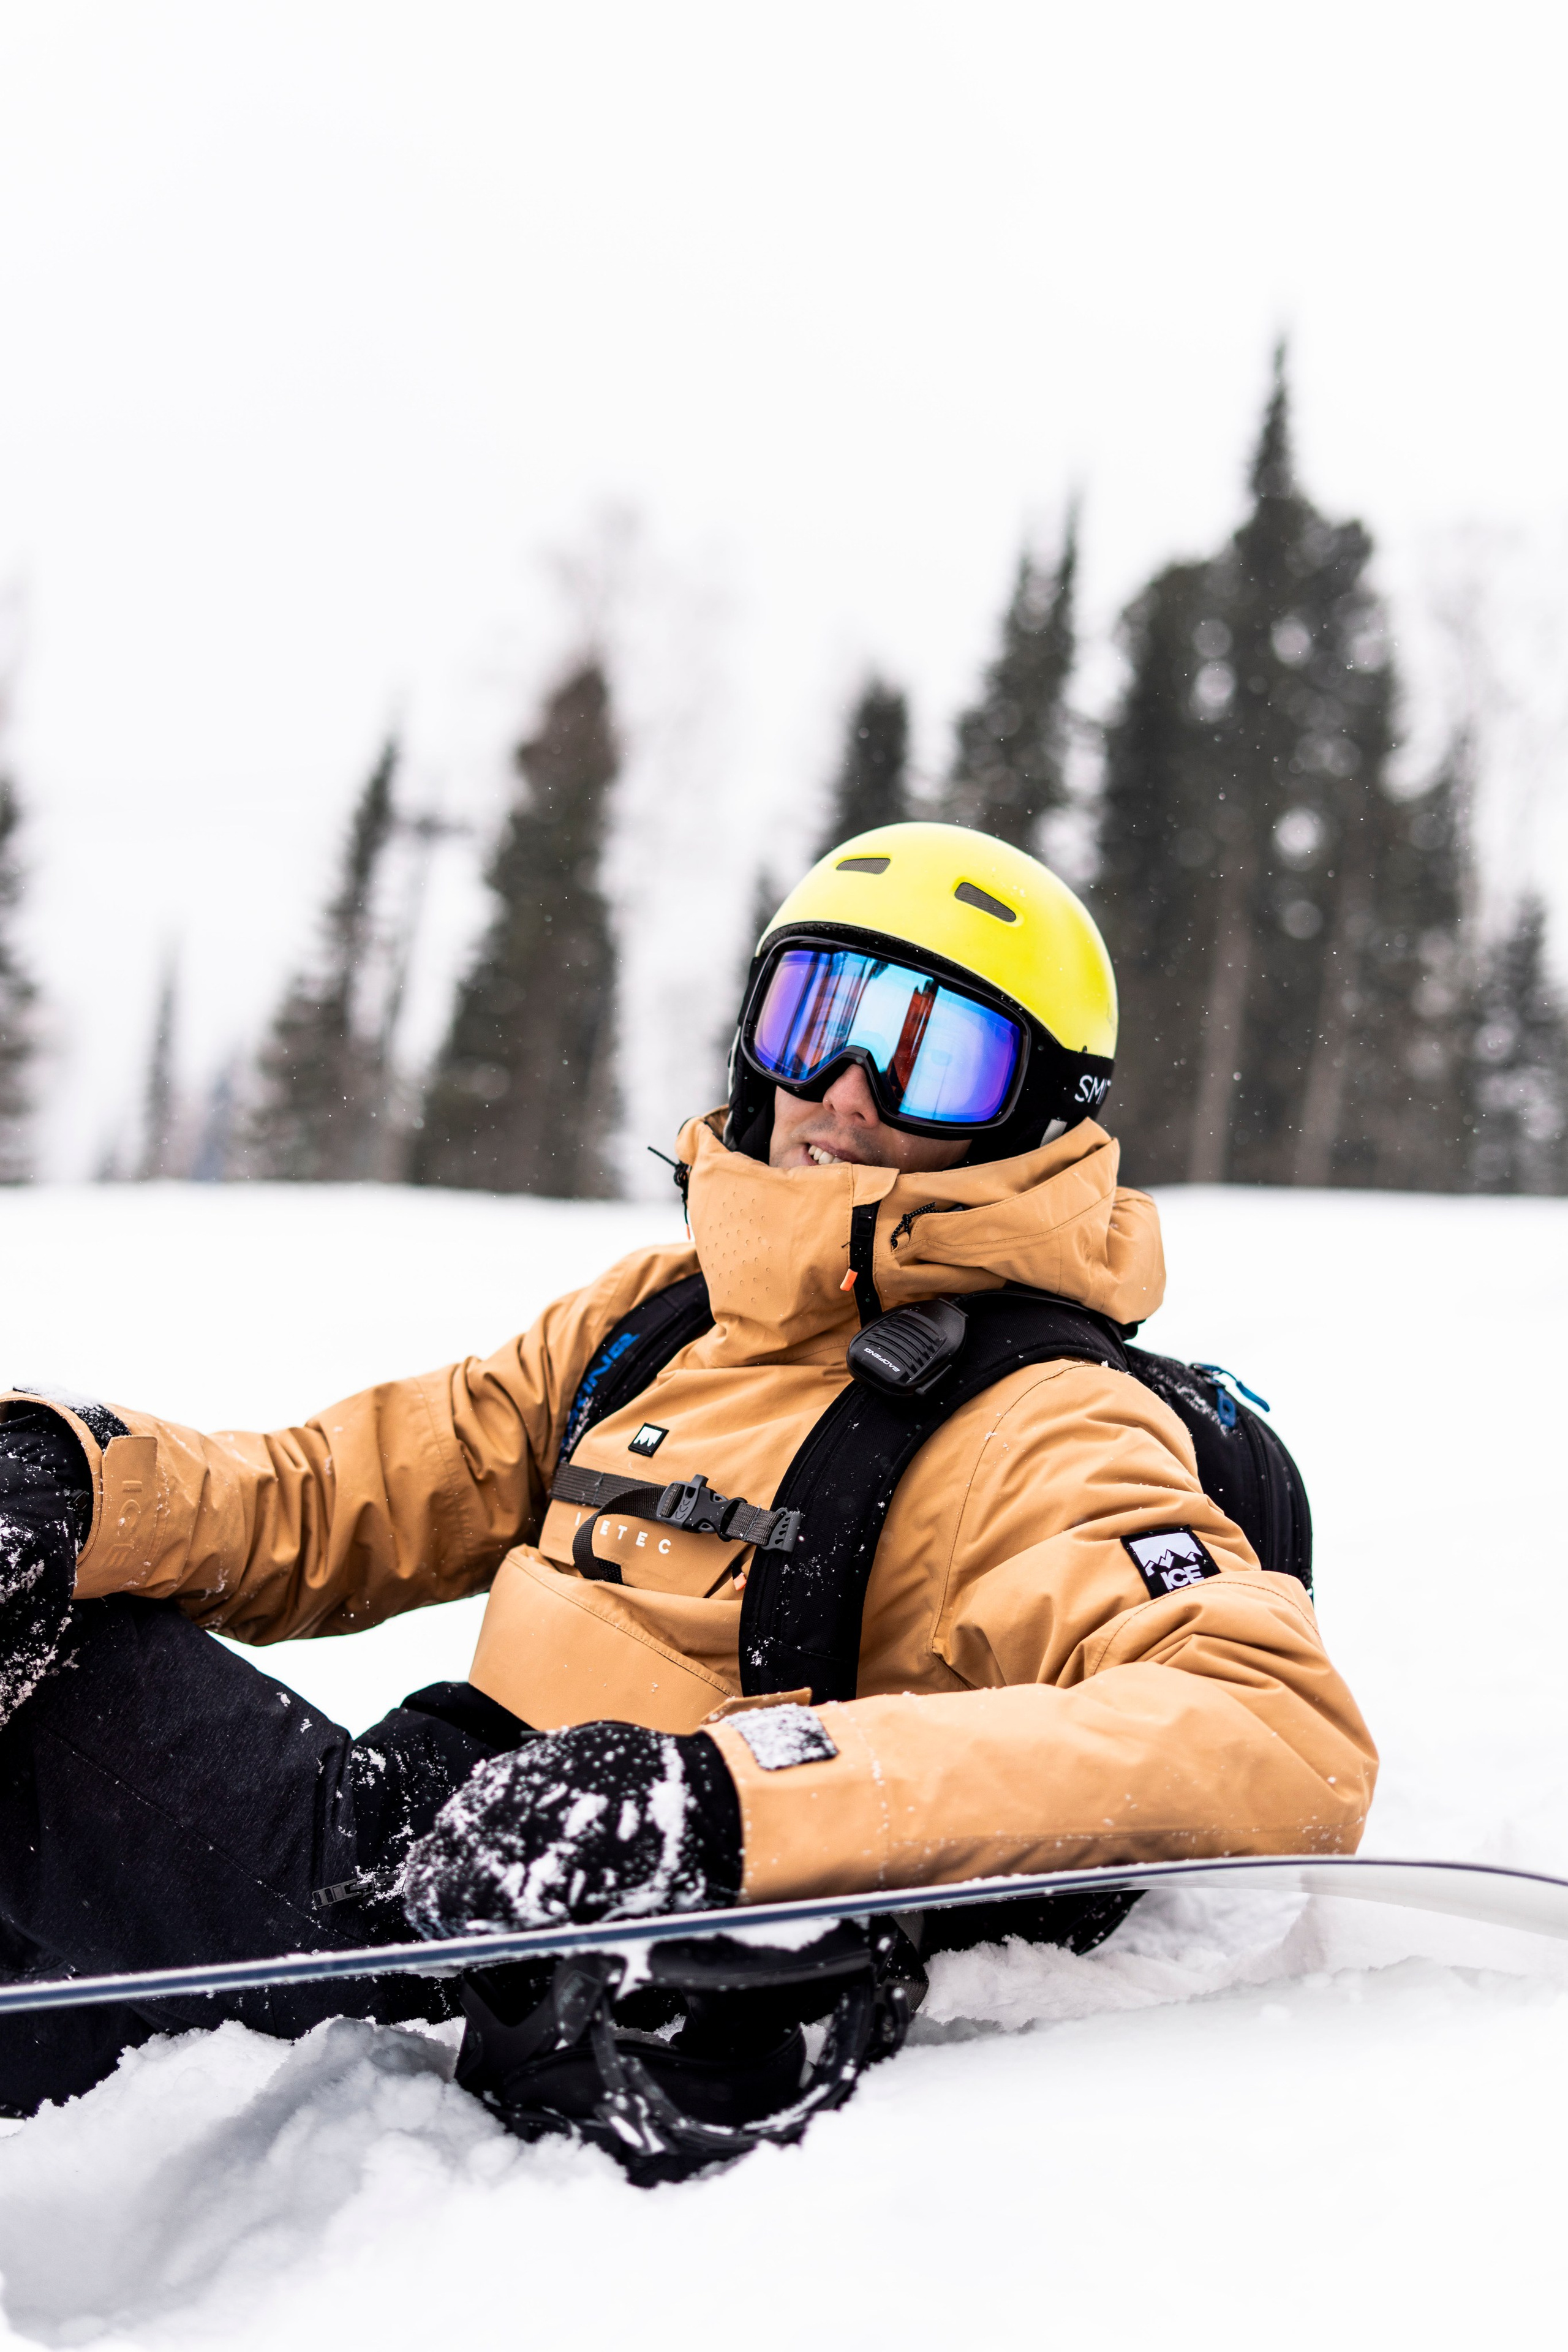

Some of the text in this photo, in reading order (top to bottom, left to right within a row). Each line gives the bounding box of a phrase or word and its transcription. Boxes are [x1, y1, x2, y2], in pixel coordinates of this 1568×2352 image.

[864, 1348, 900, 1373] BAOFENG
[575, 1512, 672, 1555] IETEC
[1160, 1564, 1205, 1591] ICE
